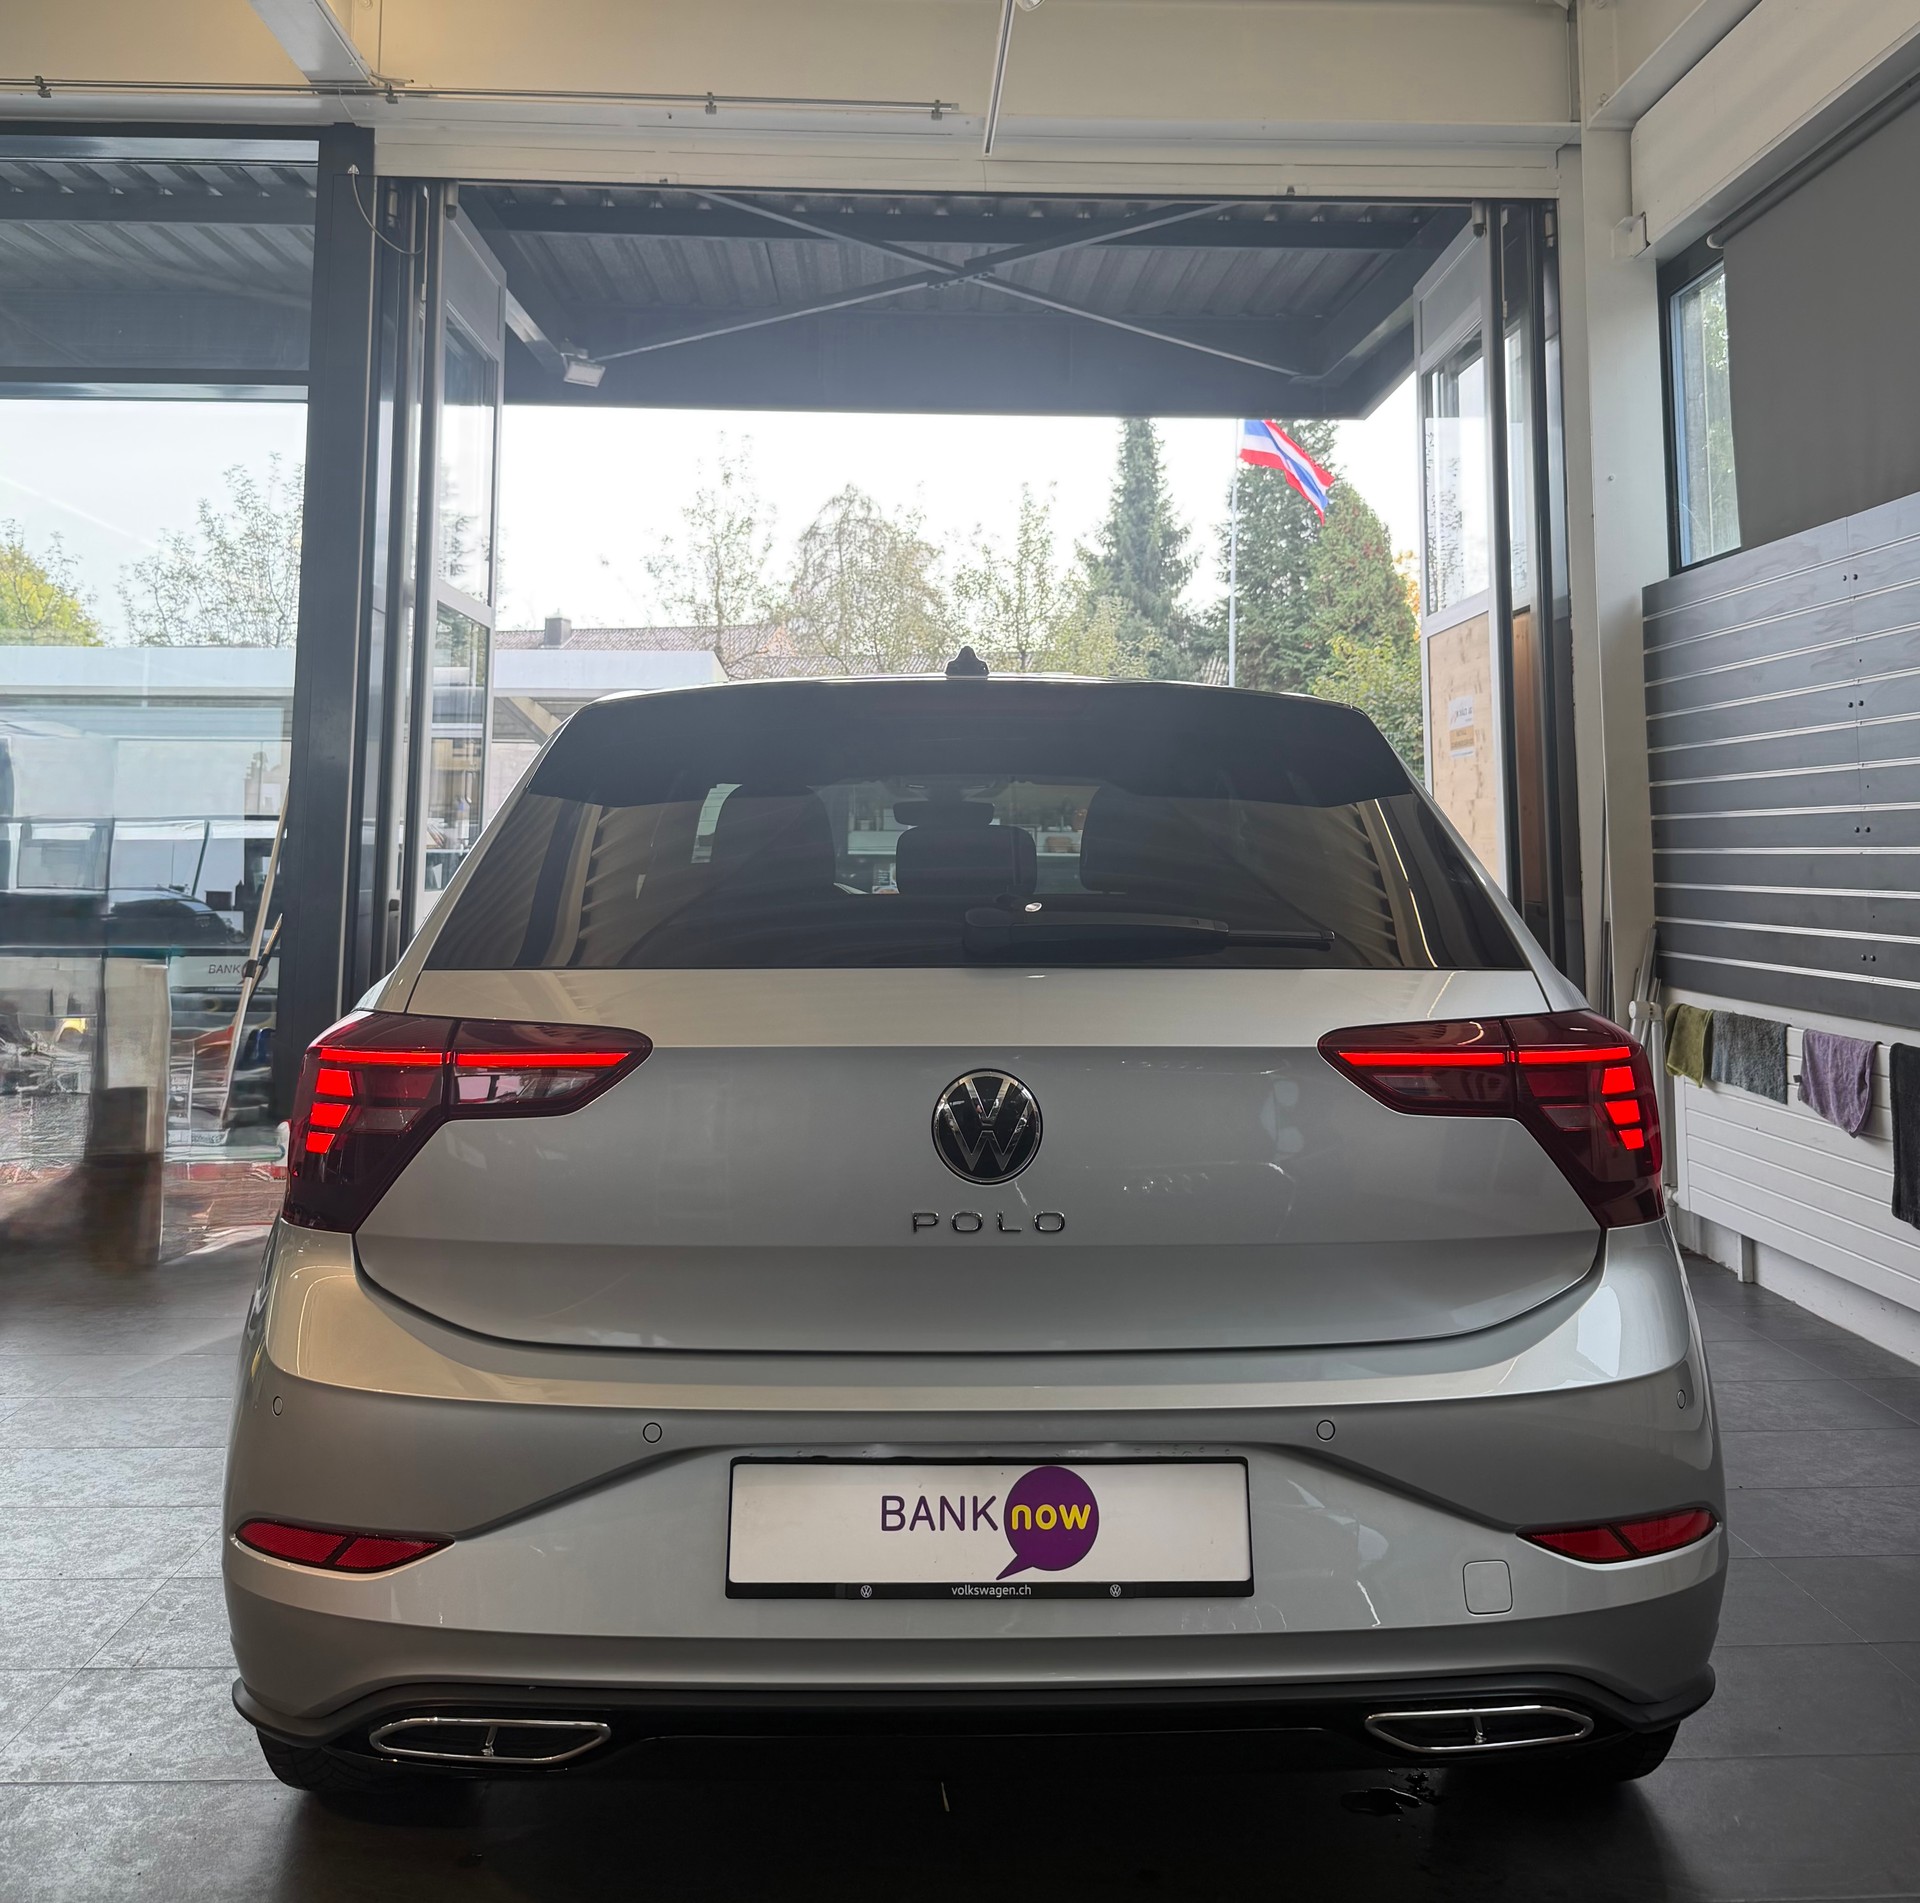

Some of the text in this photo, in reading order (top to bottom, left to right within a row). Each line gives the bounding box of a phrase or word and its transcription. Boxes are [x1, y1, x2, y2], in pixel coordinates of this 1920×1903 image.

[208, 964, 241, 974] BANK
[912, 1211, 1066, 1233] POLO
[881, 1495, 1092, 1532] BANK now
[951, 1584, 1032, 1598] volkswagen.ch
